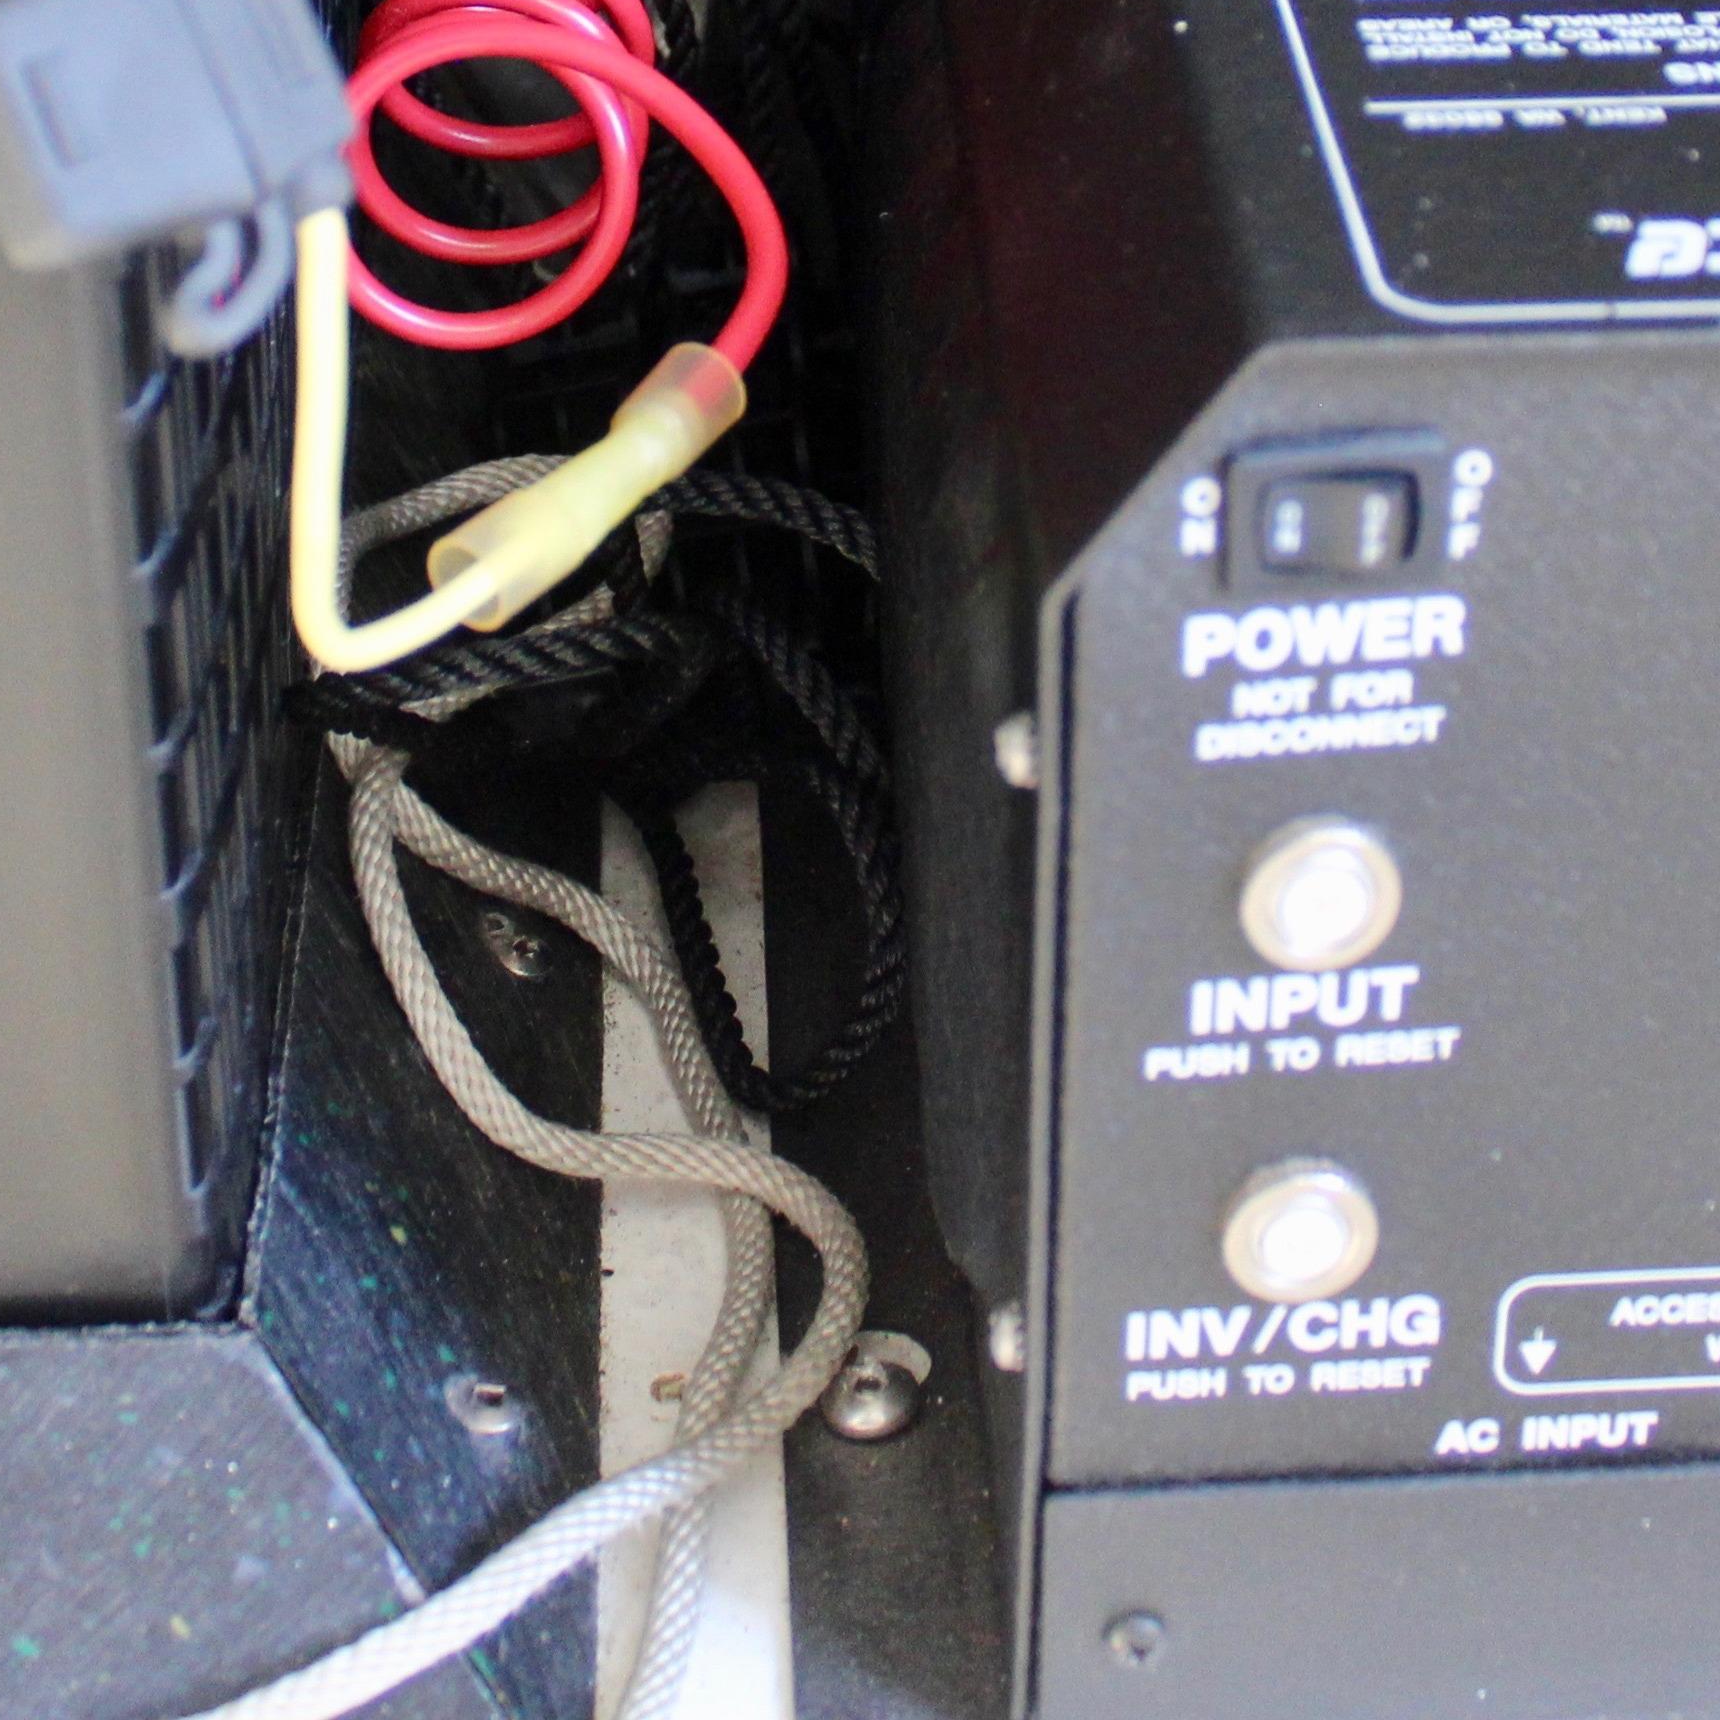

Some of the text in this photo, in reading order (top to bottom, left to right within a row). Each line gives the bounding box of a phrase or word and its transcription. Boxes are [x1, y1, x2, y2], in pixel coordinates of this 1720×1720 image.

[1449, 450, 1493, 559] OFF
[1183, 595, 1466, 680] POWER
[1232, 669, 1414, 720] NOT FOR
[1196, 707, 1446, 761] DISCONNECT
[1190, 968, 1422, 1038] INPUT
[1145, 1044, 1250, 1080] PUSH
[1266, 1038, 1320, 1071] TO
[1126, 1300, 1440, 1364] INV/CHG
[1127, 1368, 1226, 1400] PUSH
[1243, 1364, 1295, 1395] TO
[1435, 1411, 1659, 1454] AC INPUT
